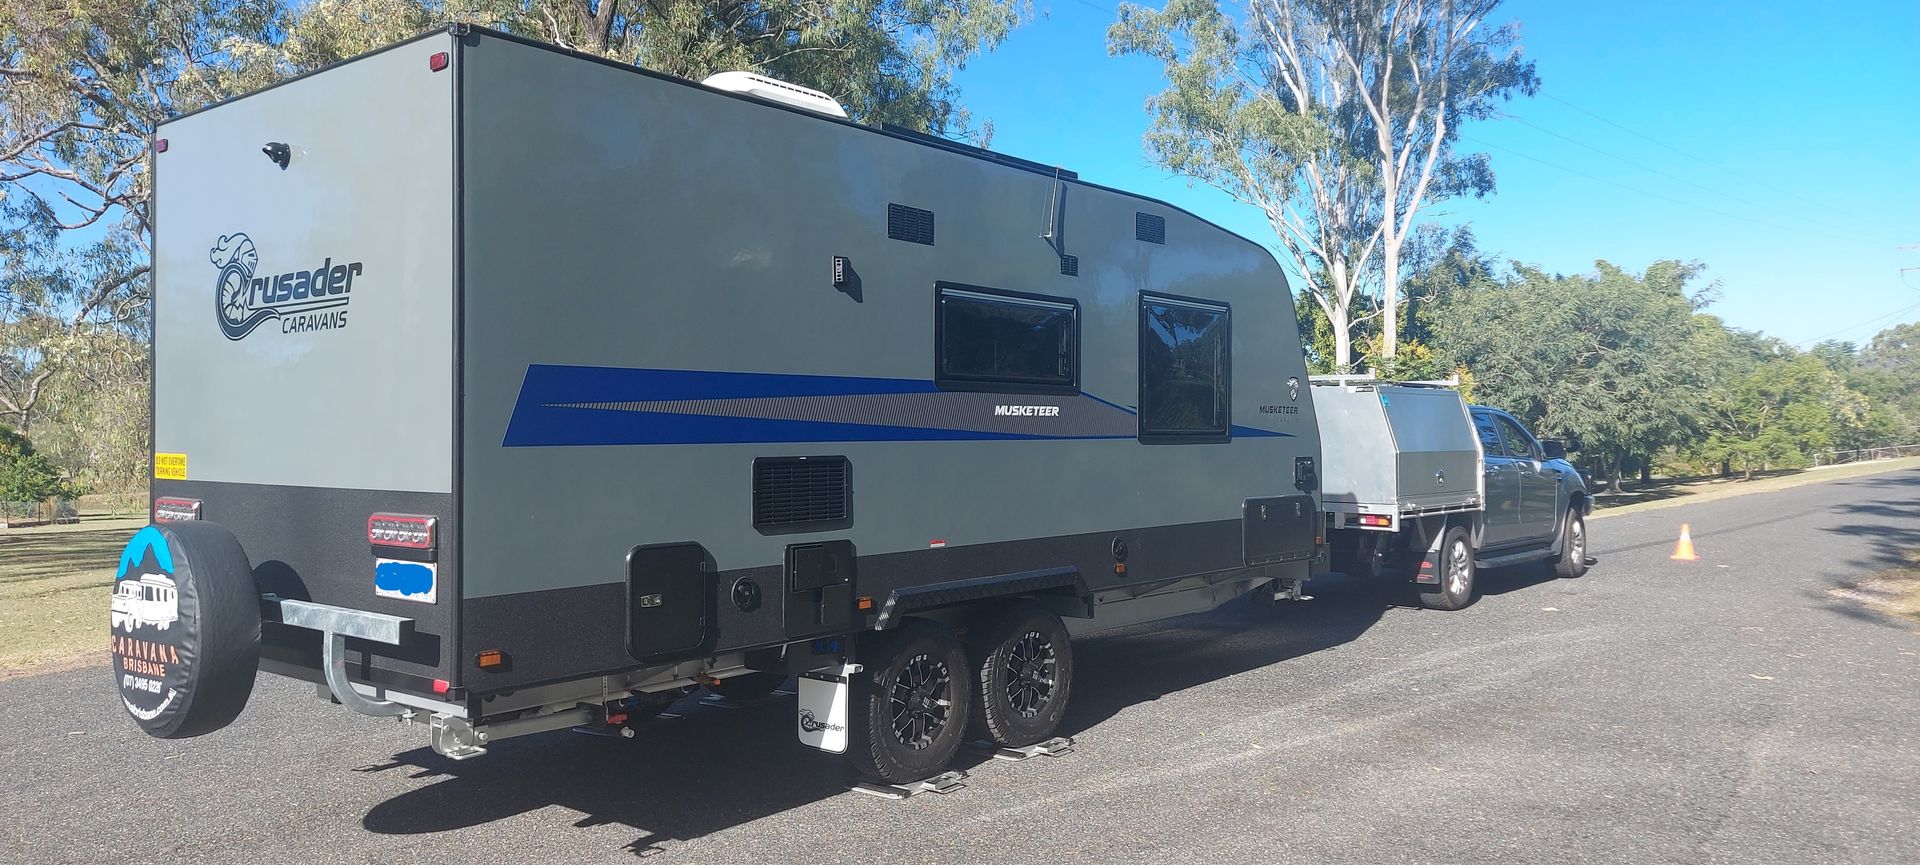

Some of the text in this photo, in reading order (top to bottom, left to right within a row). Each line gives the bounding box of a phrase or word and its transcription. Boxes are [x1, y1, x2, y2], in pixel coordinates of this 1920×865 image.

[282, 311, 348, 334] CARAVANS
[995, 405, 1060, 417] MUSKETEER
[1259, 405, 1299, 414] MUSKETEER
[111, 635, 179, 664] CARAVANA
[123, 657, 165, 677] BRISBANE
[123, 674, 134, 690] (07)
